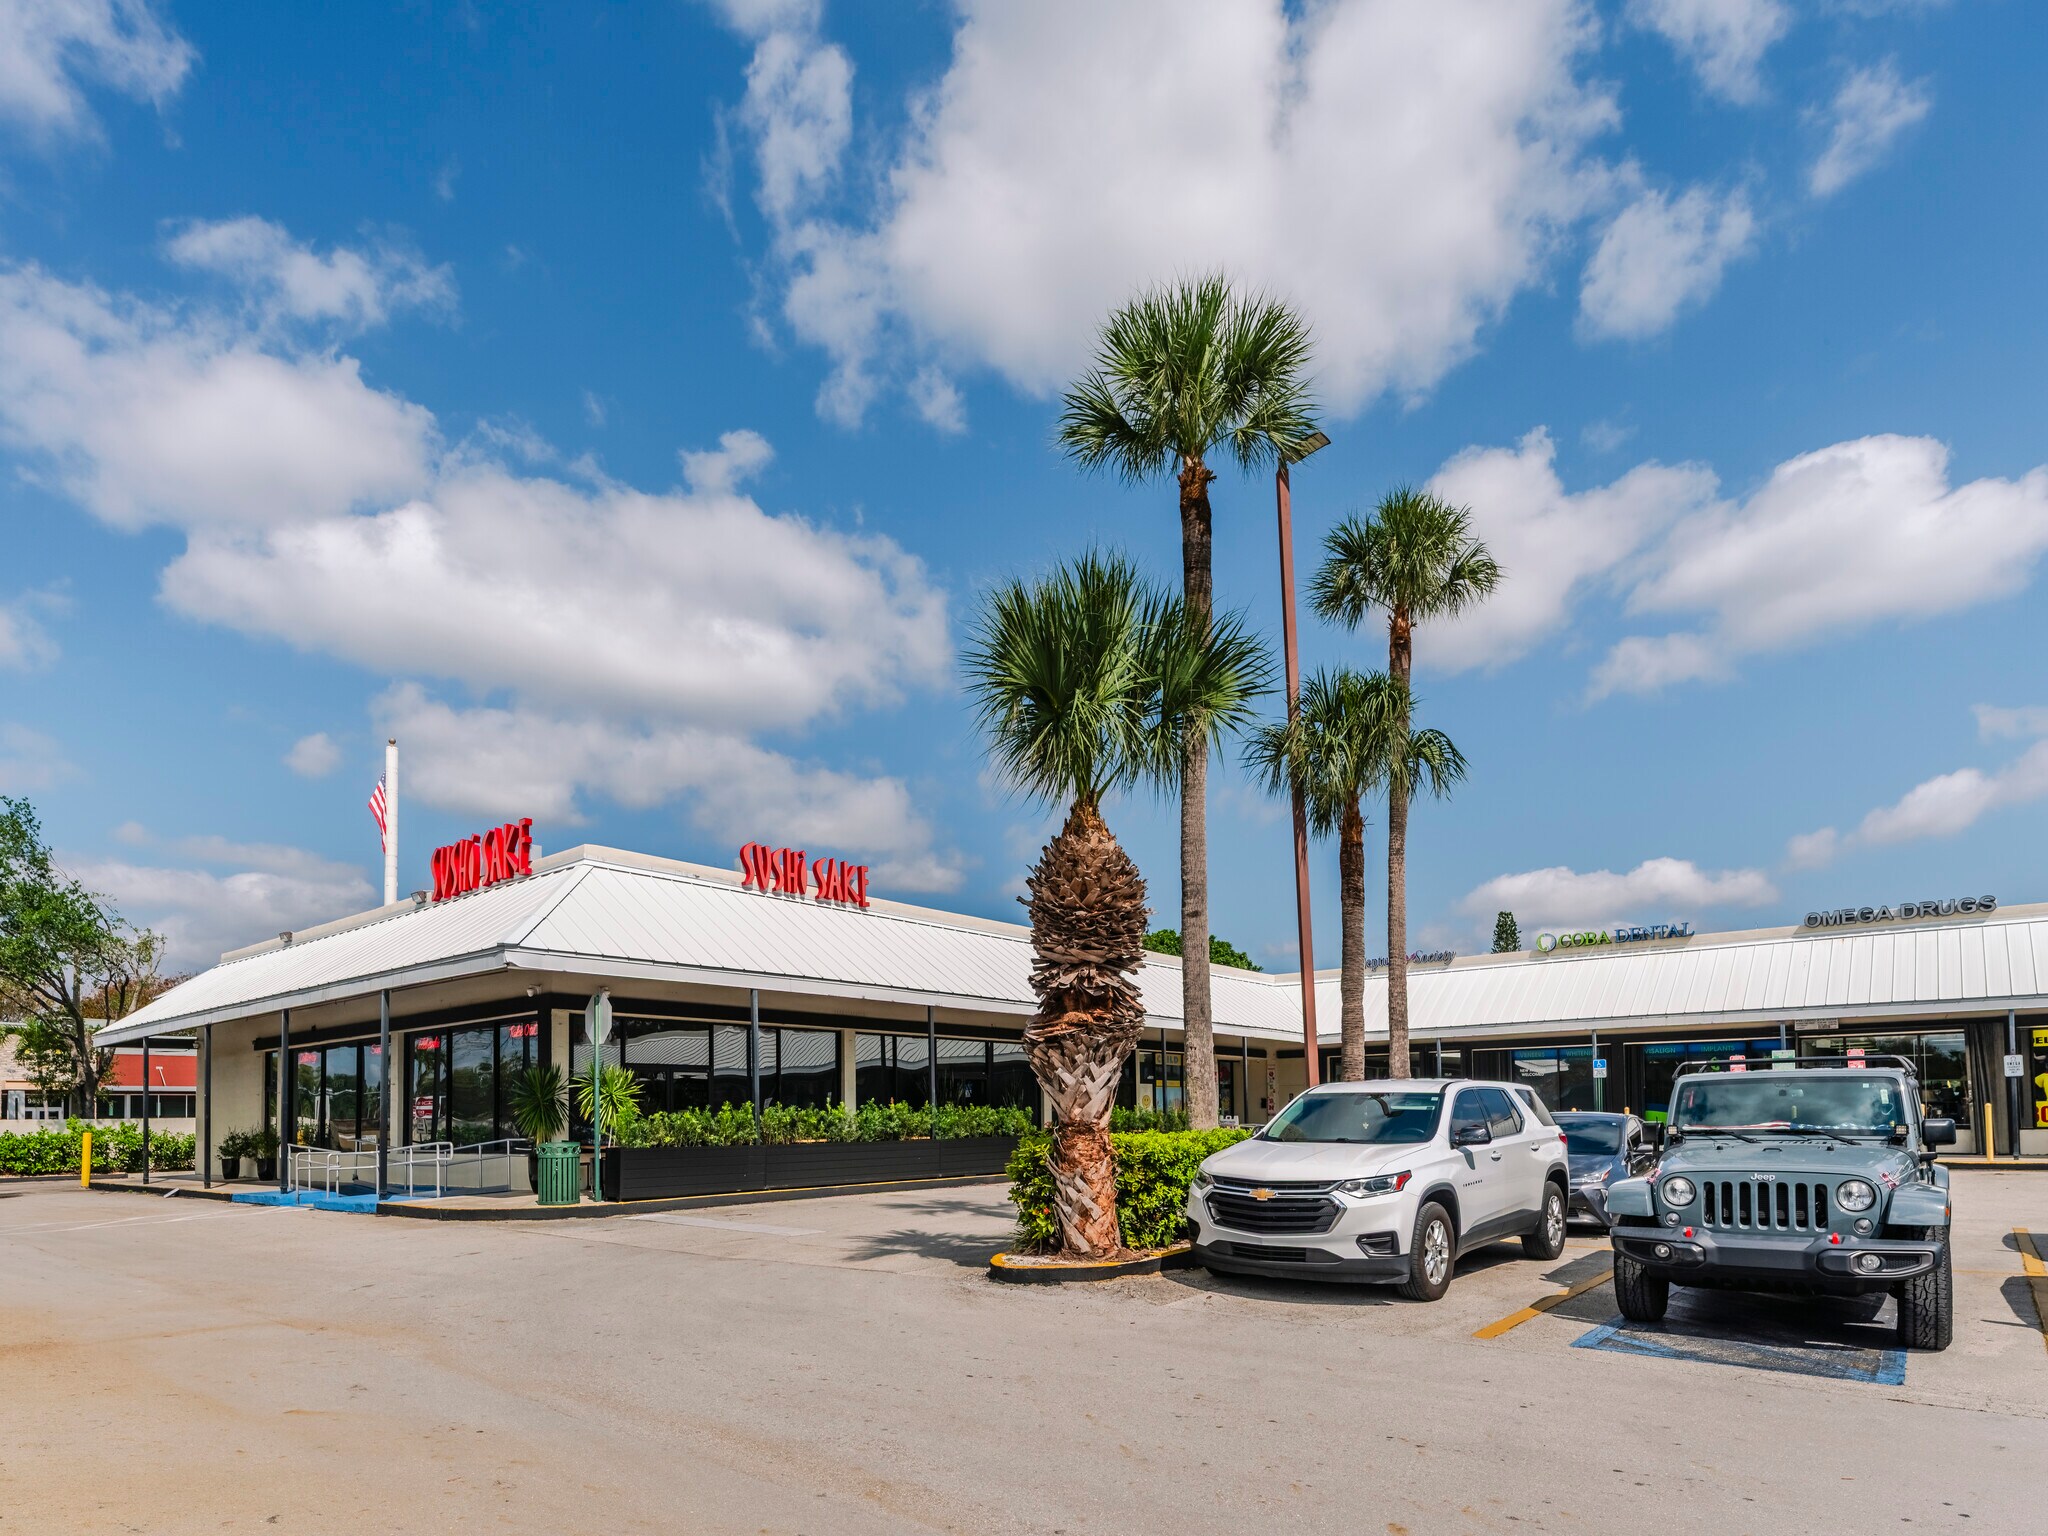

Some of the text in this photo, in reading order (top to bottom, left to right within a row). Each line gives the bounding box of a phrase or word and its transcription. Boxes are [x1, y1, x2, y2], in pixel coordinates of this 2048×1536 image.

[481, 817, 532, 887] SAKE
[812, 857, 870, 907] SAKE
[1804, 895, 1997, 928] OMEGA DRUGS
[1558, 922, 1695, 948] COBA DENTAL
[1413, 950, 1456, 966] Society
[1157, 1054, 1179, 1064] CILD
[1750, 1173, 1776, 1181] Jeep
